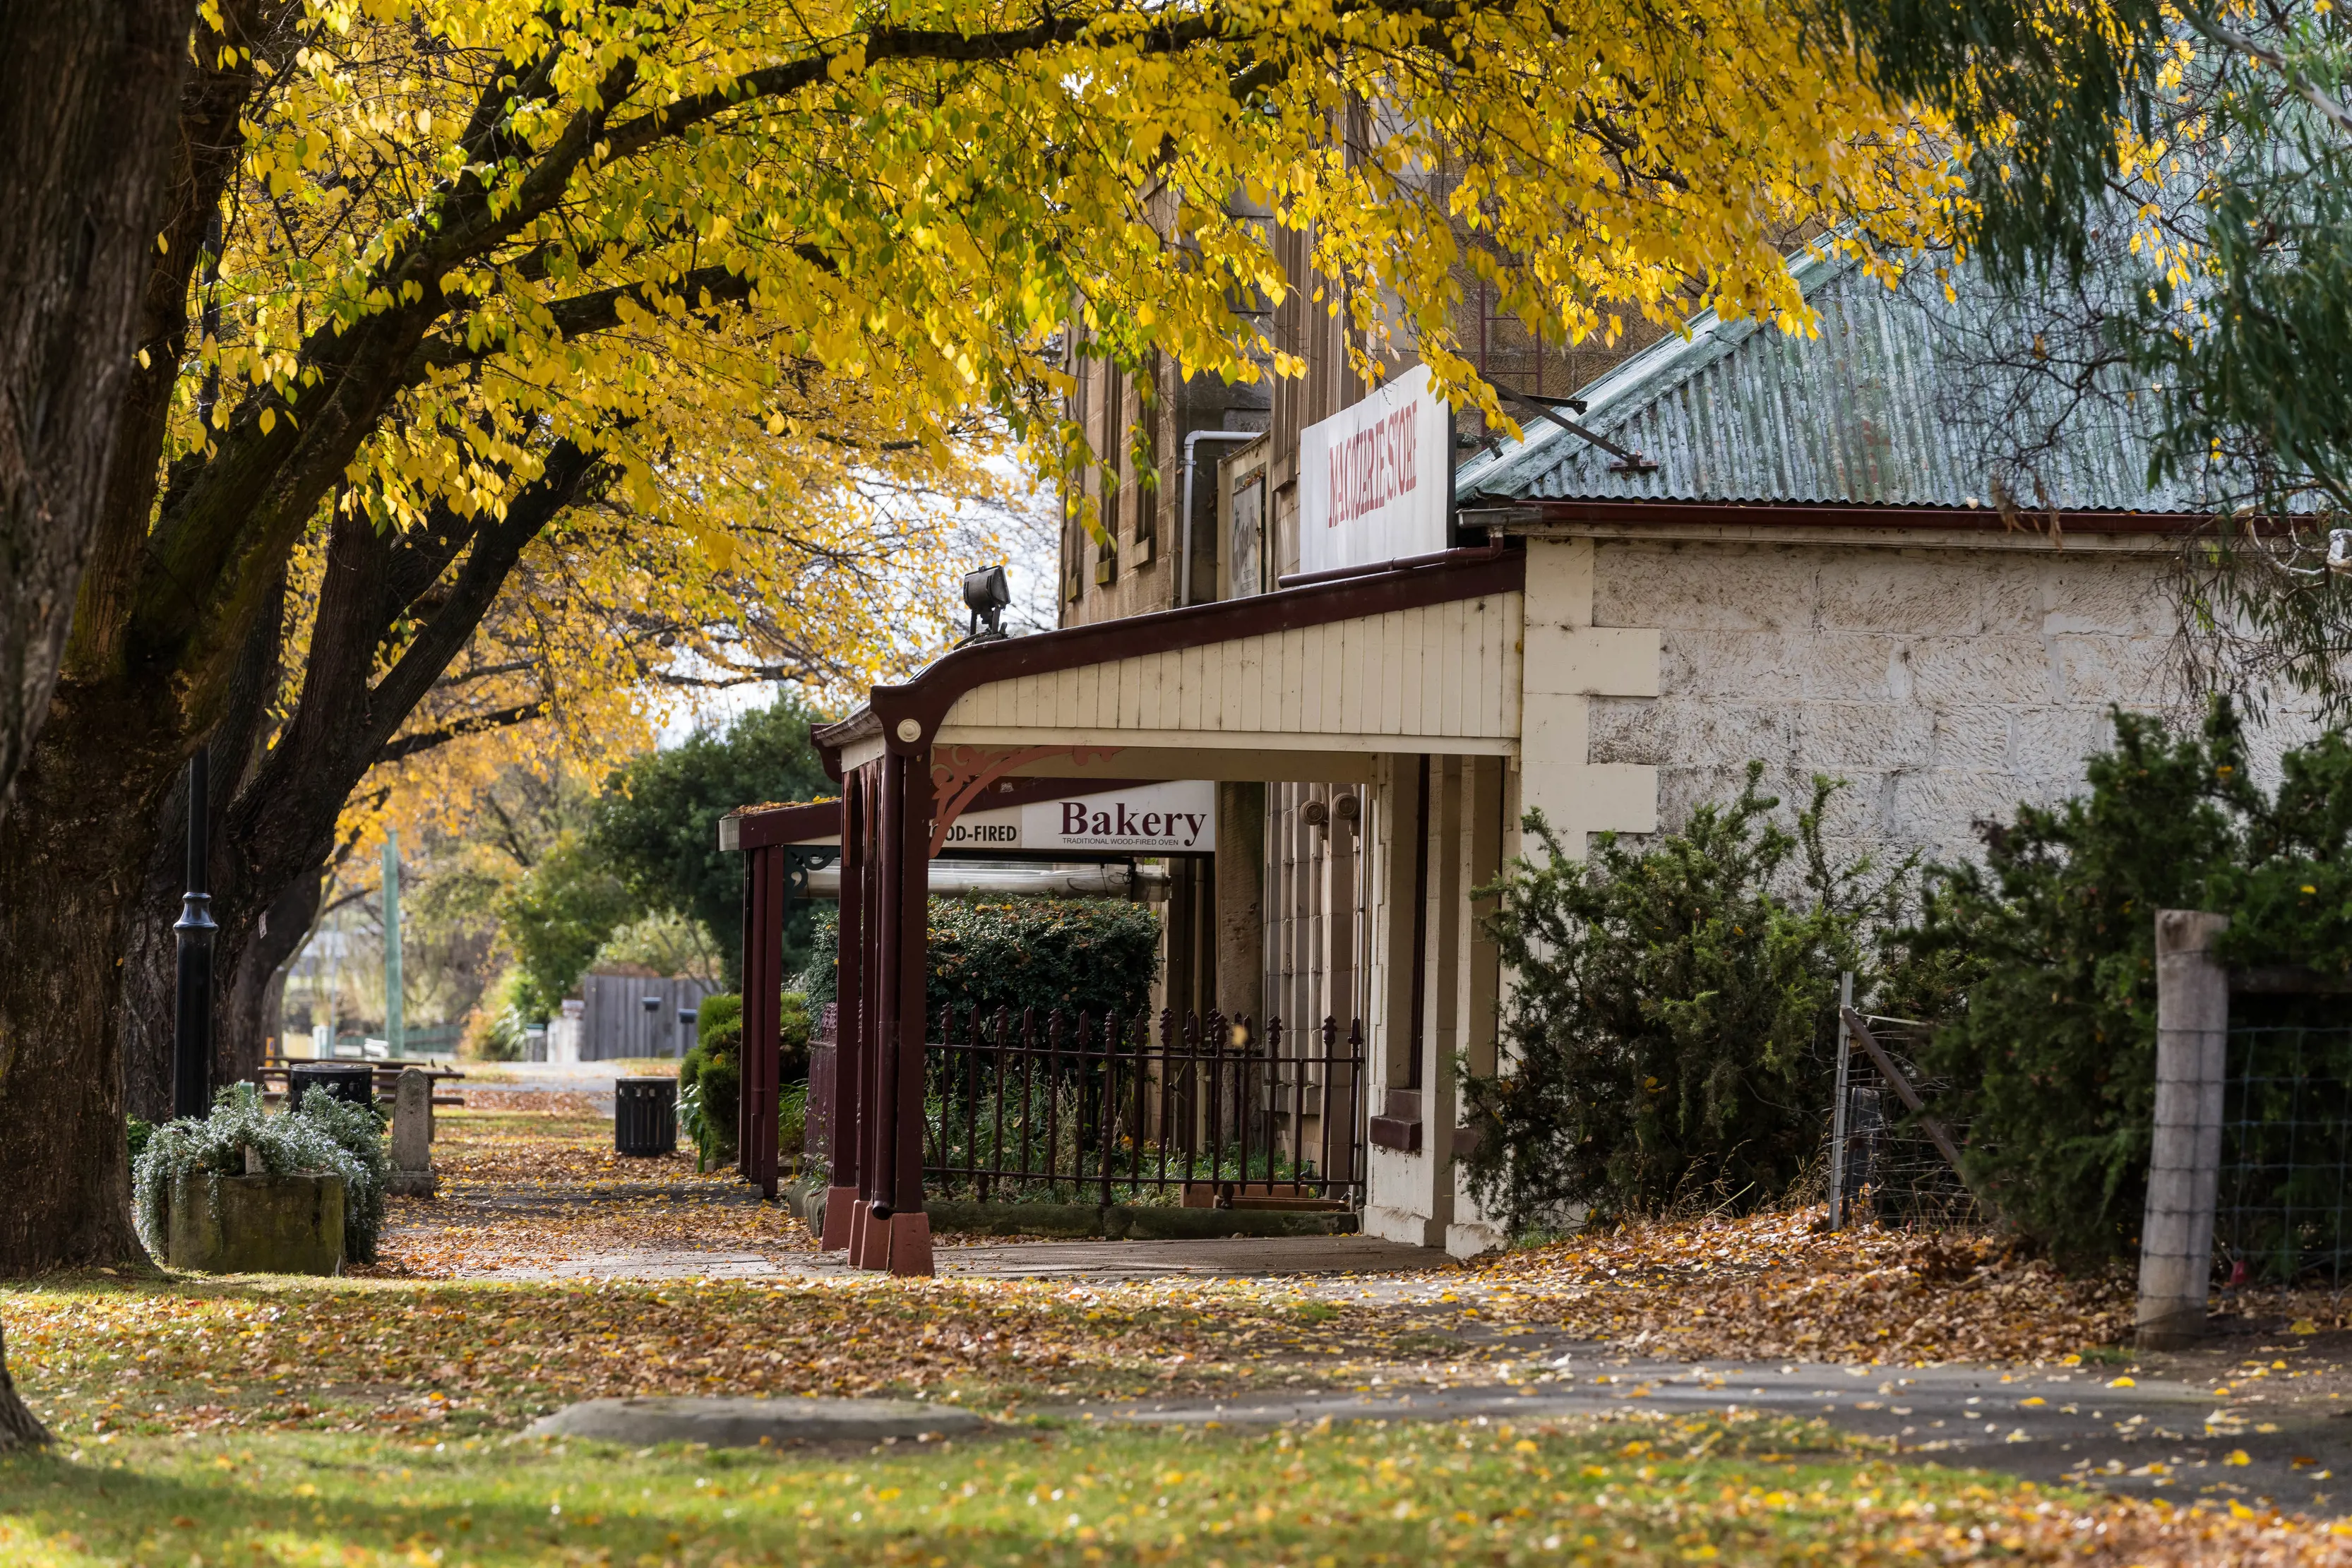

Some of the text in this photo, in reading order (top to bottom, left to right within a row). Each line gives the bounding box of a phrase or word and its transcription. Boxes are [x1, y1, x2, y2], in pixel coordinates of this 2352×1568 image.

[1328, 399, 1417, 528] MACQUARIE STORE
[929, 825, 1017, 842] OD-FIRED
[1058, 802, 1207, 846] Bakery
